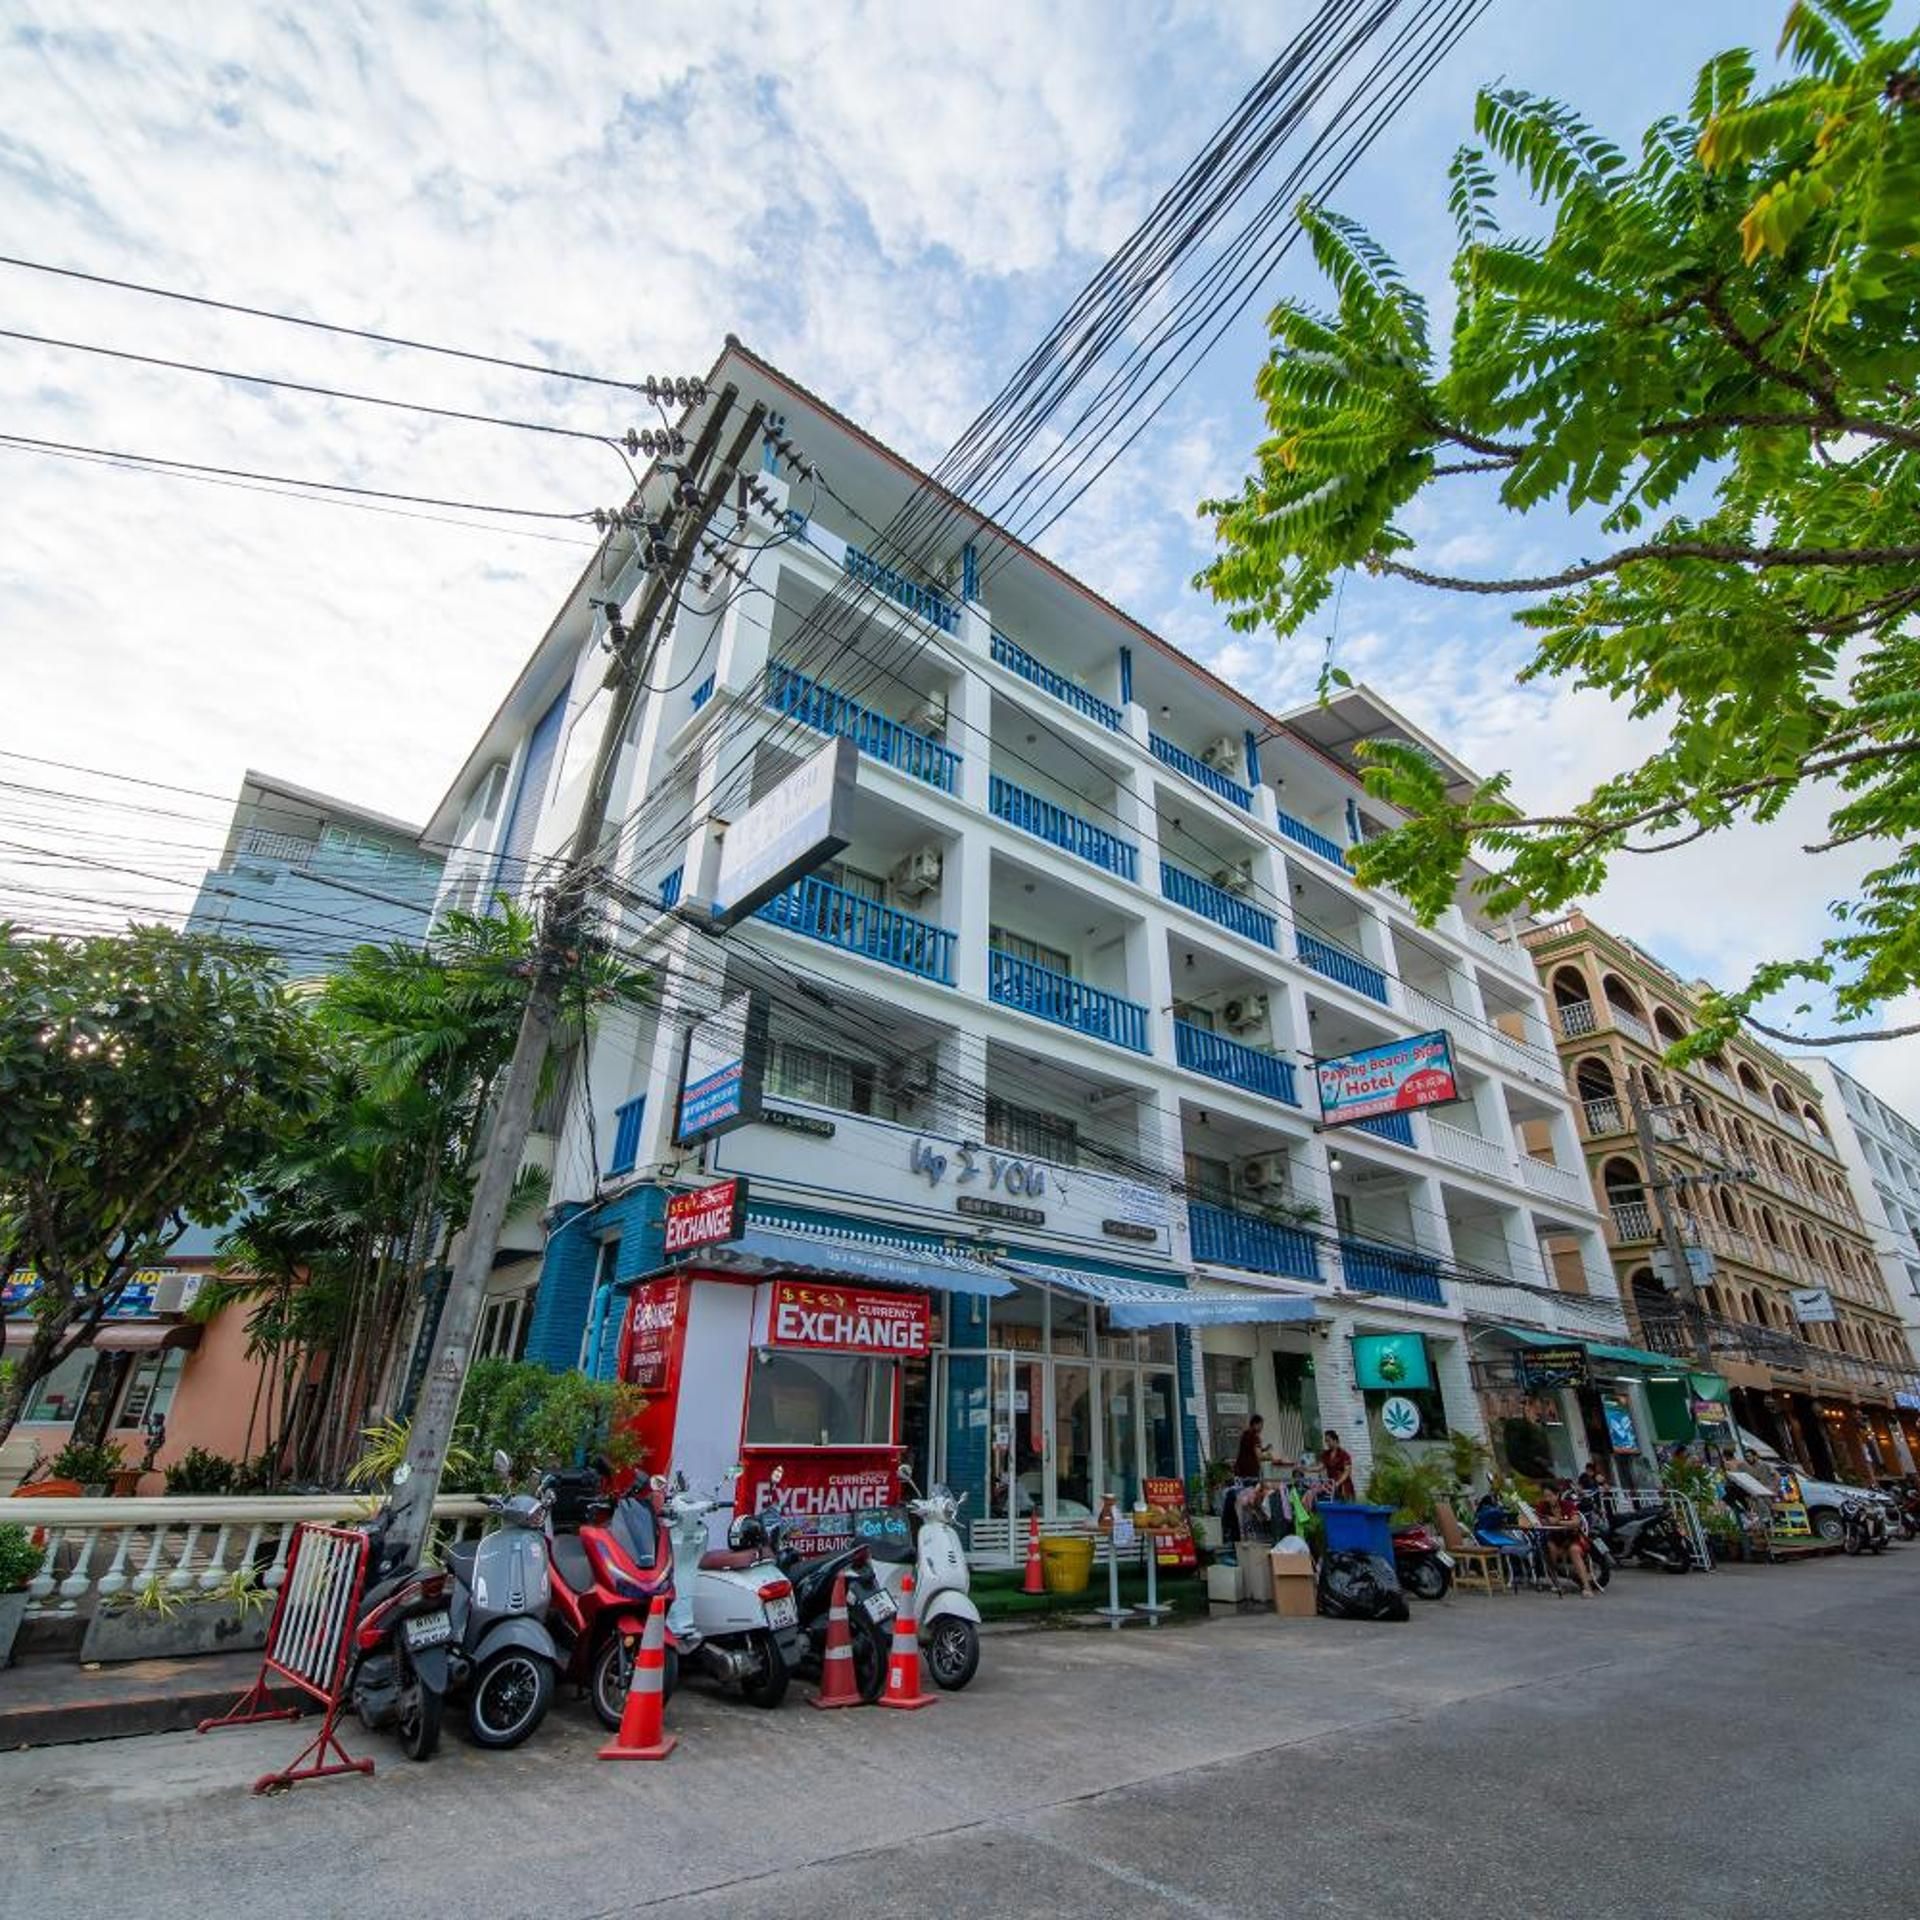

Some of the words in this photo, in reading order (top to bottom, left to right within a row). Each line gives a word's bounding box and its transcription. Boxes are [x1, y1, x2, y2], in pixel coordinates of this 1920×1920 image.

[1370, 1051, 1408, 1070] Beach
[1345, 1071, 1395, 1096] Hotel
[666, 1205, 732, 1249] EXCHANGE
[857, 1305, 917, 1320] CURRENCY
[777, 1303, 925, 1349] EXCHANGE
[829, 1474, 888, 1485] CURRENCY
